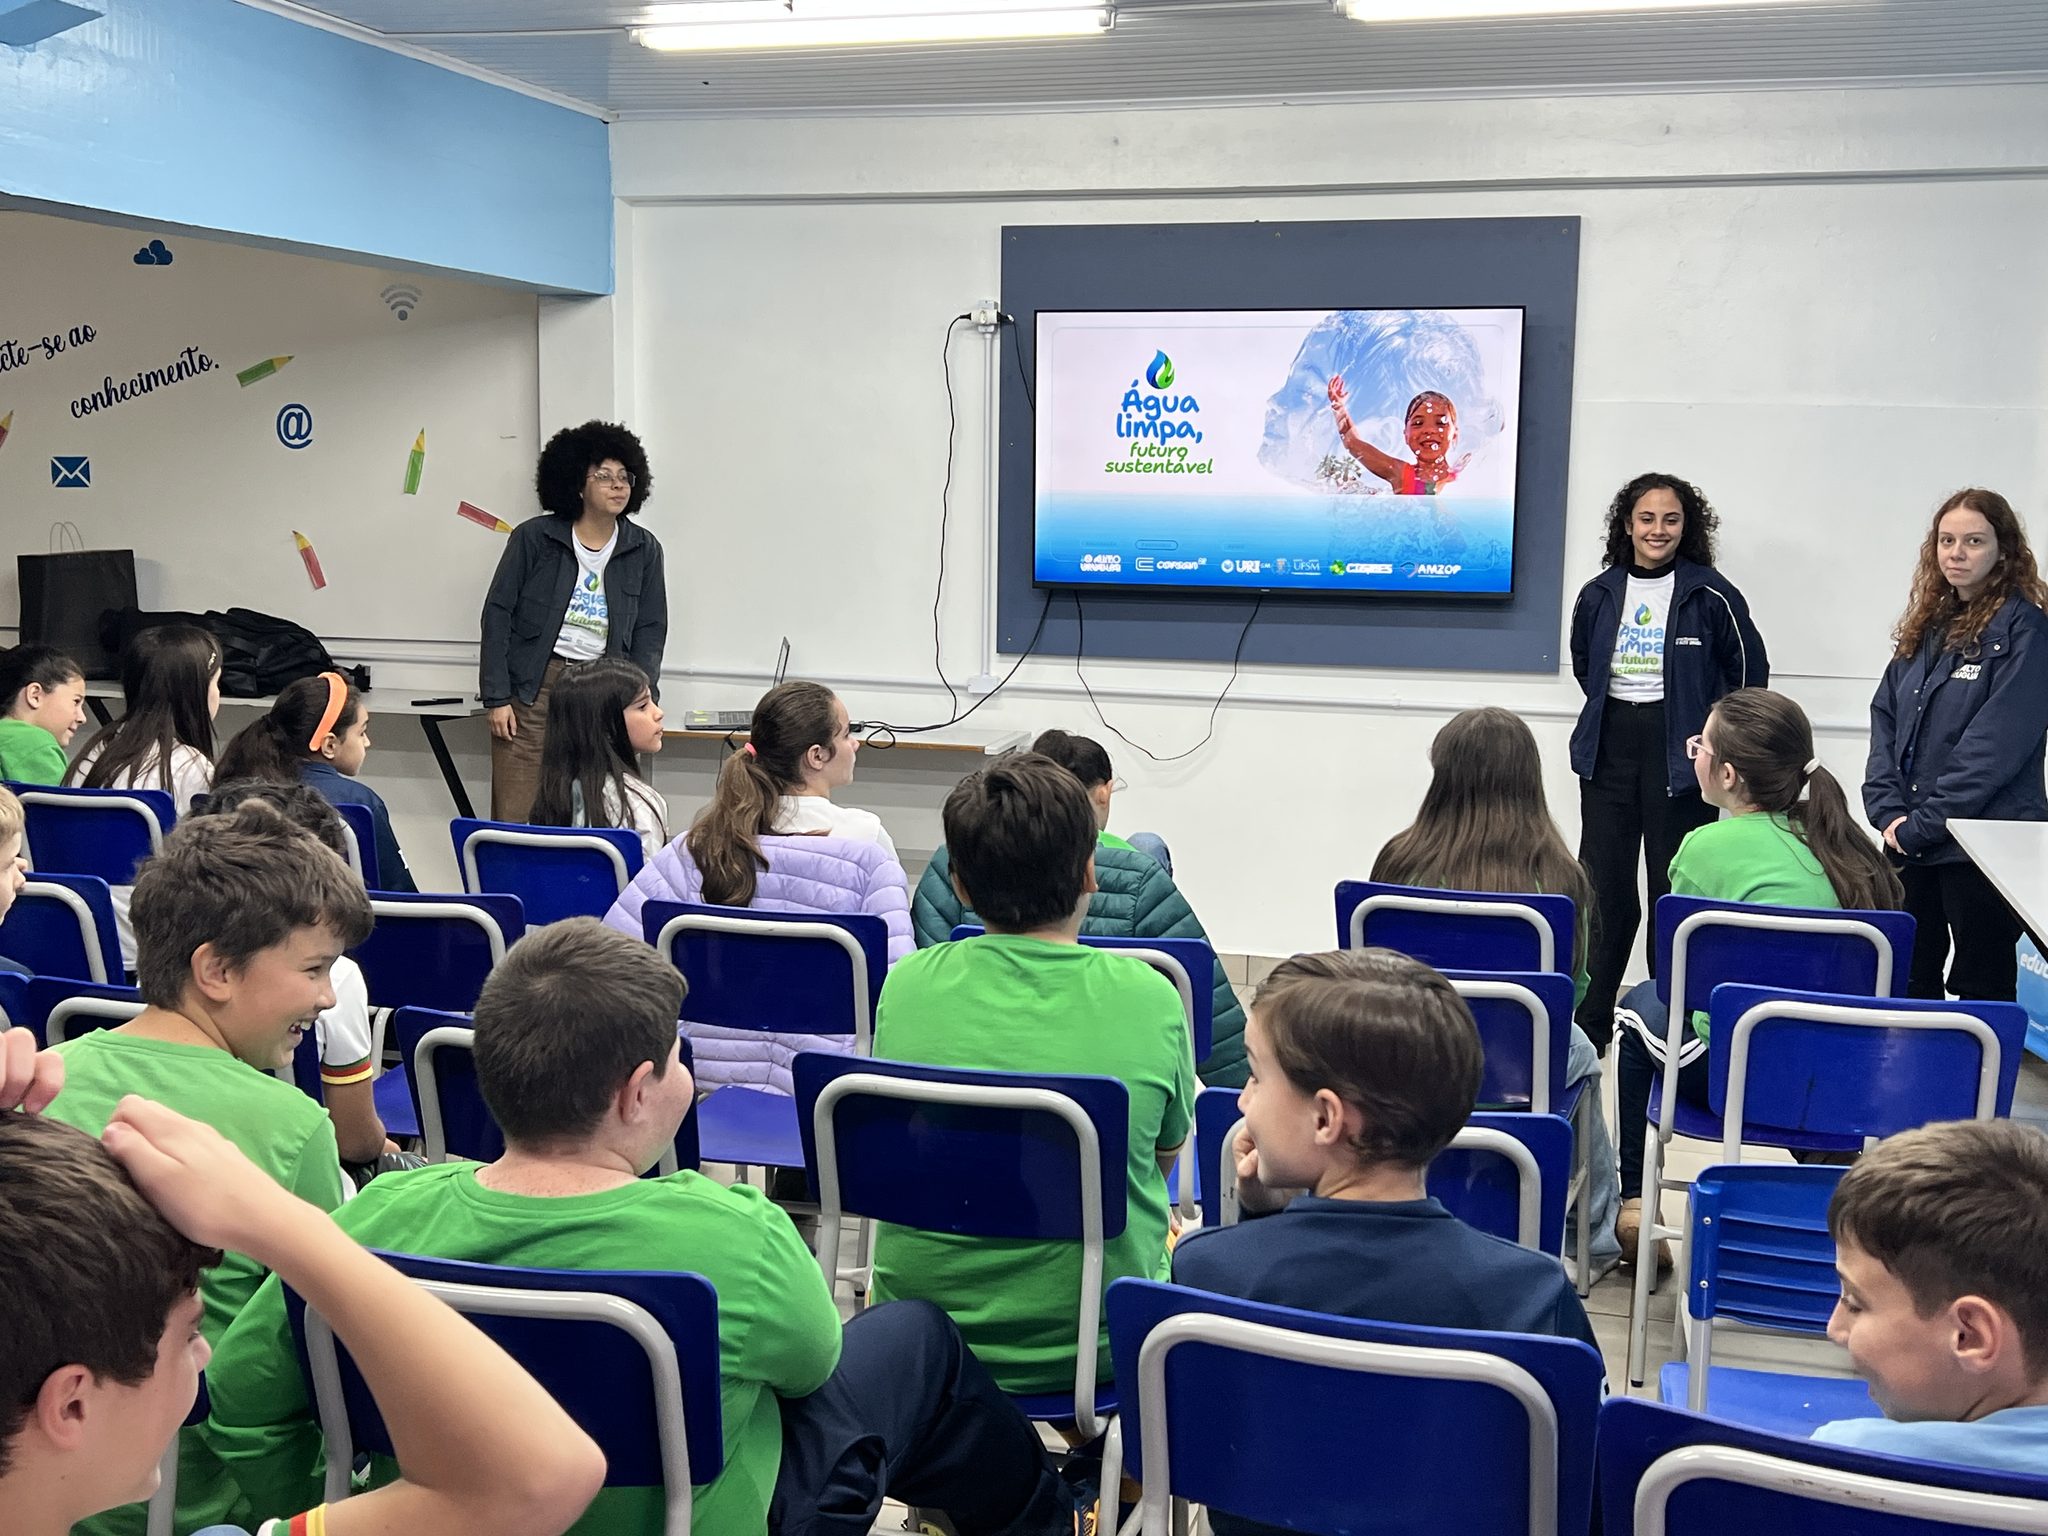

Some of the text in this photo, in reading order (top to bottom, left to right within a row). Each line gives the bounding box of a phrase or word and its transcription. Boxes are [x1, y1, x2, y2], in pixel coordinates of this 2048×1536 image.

[0, 324, 97, 373] cte-se ao
[70, 346, 220, 419] conhecimento.
[1121, 379, 1200, 421] Água
[1116, 413, 1203, 446] limpa,
[1130, 442, 1188, 458] futuro
[1104, 458, 1213, 474] sustentável
[1293, 559, 1320, 571] UFSM
[571, 602, 608, 618] impa
[1621, 654, 1659, 665] futuro
